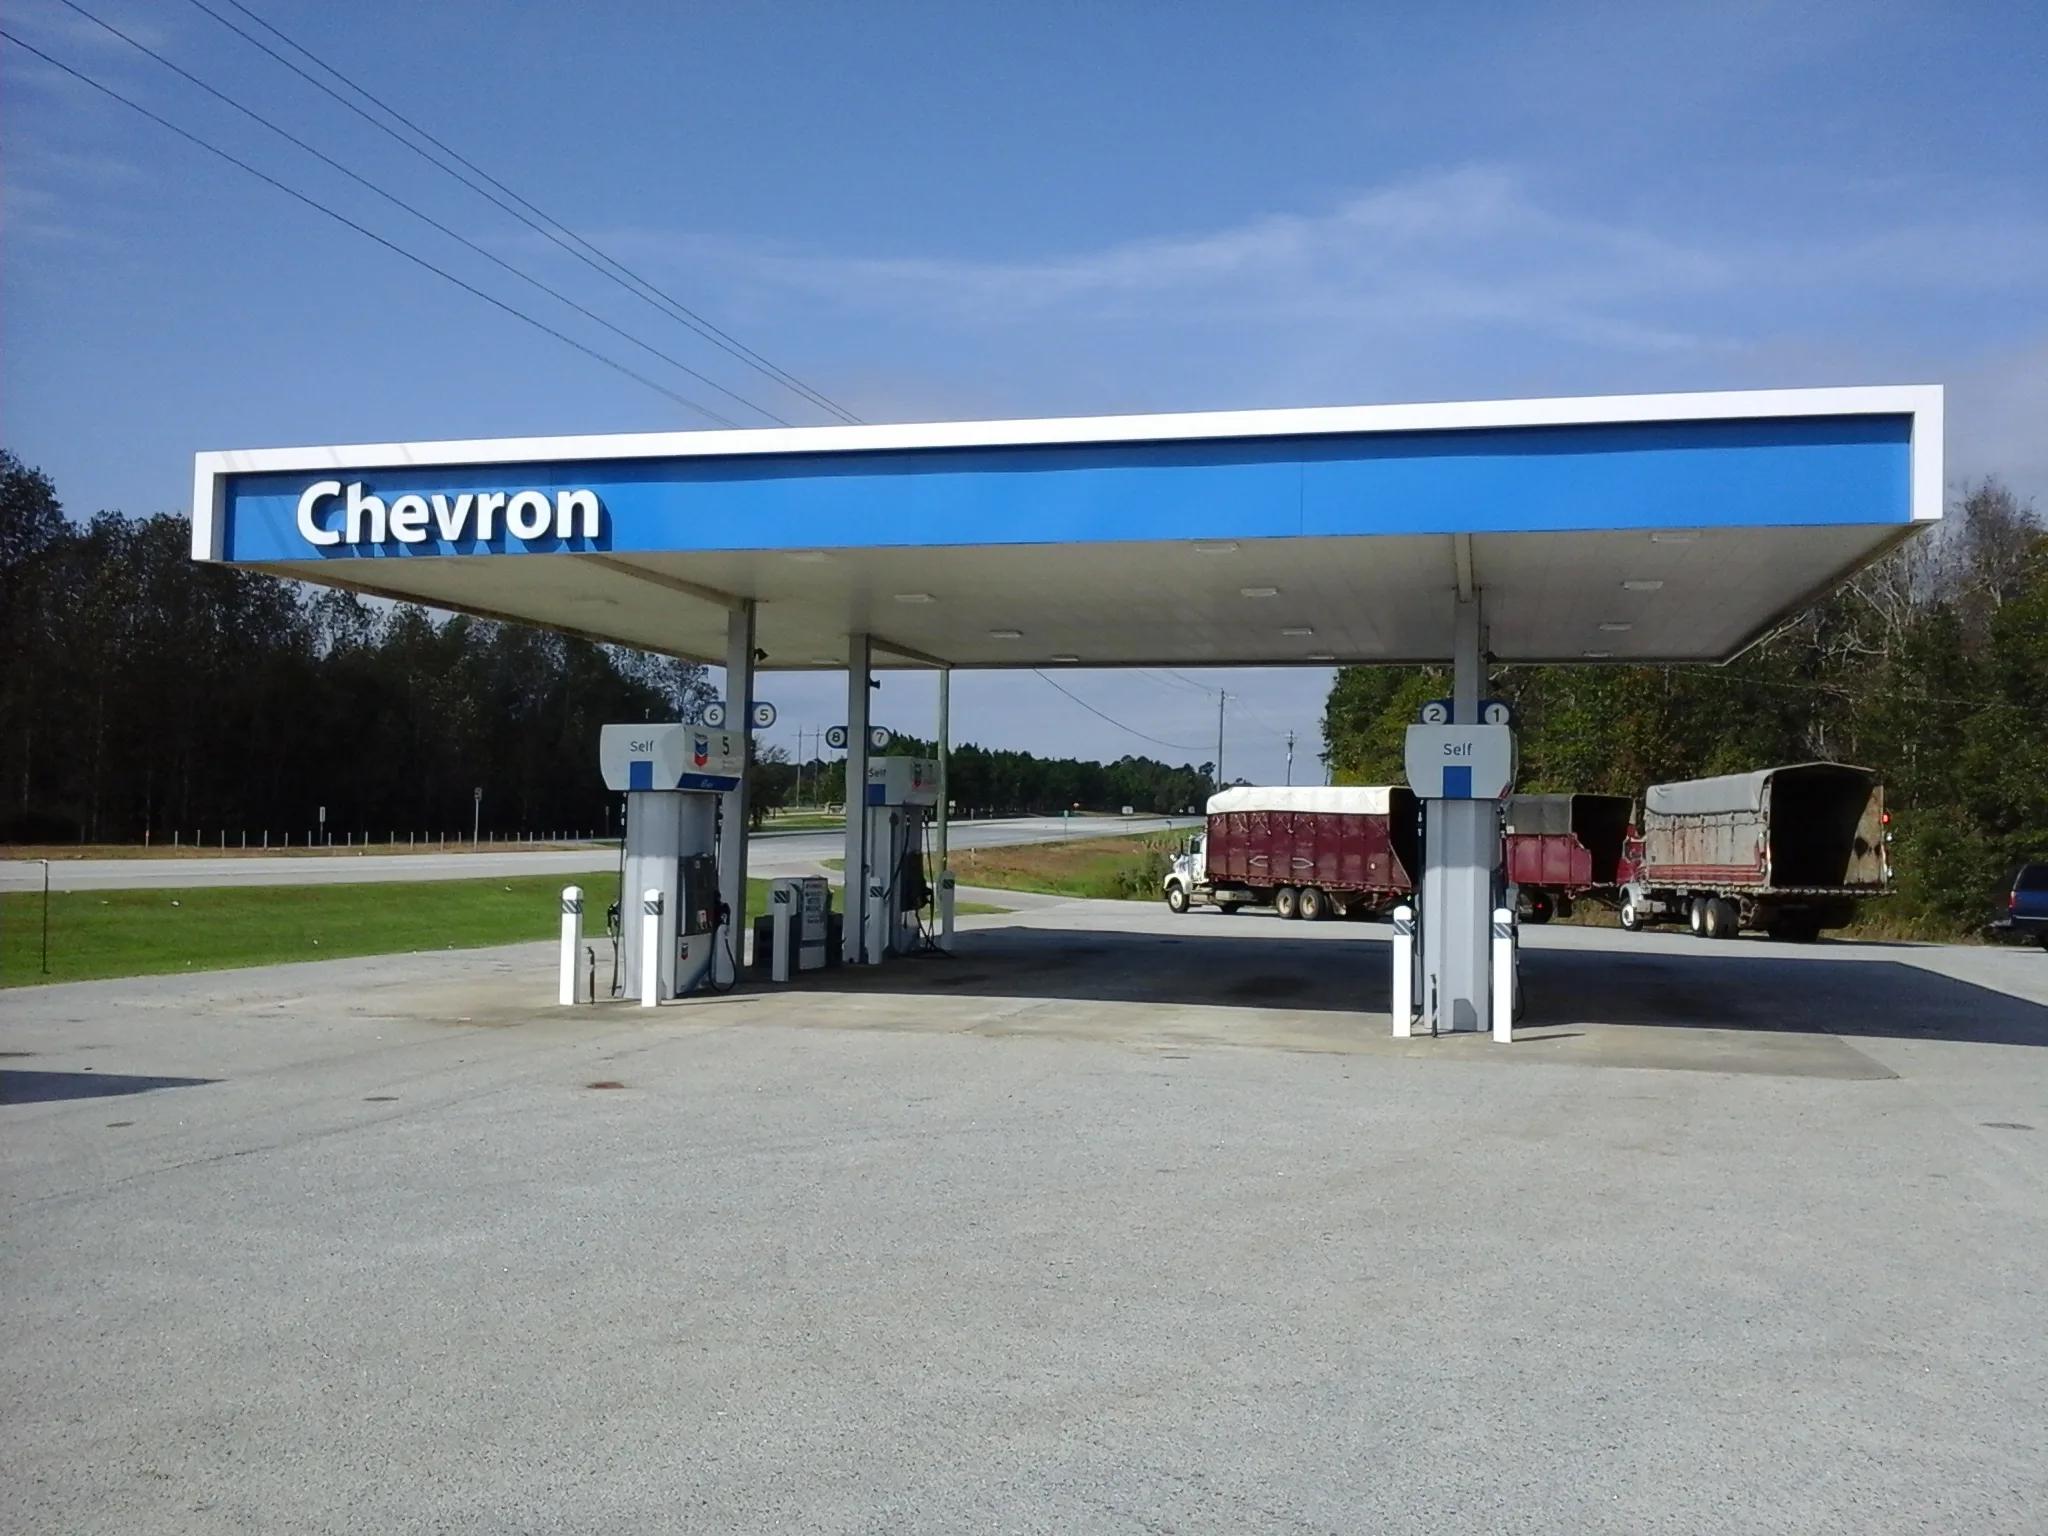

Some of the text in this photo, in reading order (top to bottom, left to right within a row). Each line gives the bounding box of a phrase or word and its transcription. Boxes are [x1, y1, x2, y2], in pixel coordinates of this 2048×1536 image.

[297, 480, 600, 545] Chevron
[709, 708, 719, 721] 6
[759, 708, 769, 721] 5
[1429, 708, 1441, 722] 2
[1493, 708, 1500, 722] 1
[831, 731, 841, 743] 8
[876, 731, 885, 744] 7
[629, 740, 655, 752] Self
[722, 735, 730, 756] 5
[1443, 742, 1473, 756] Self
